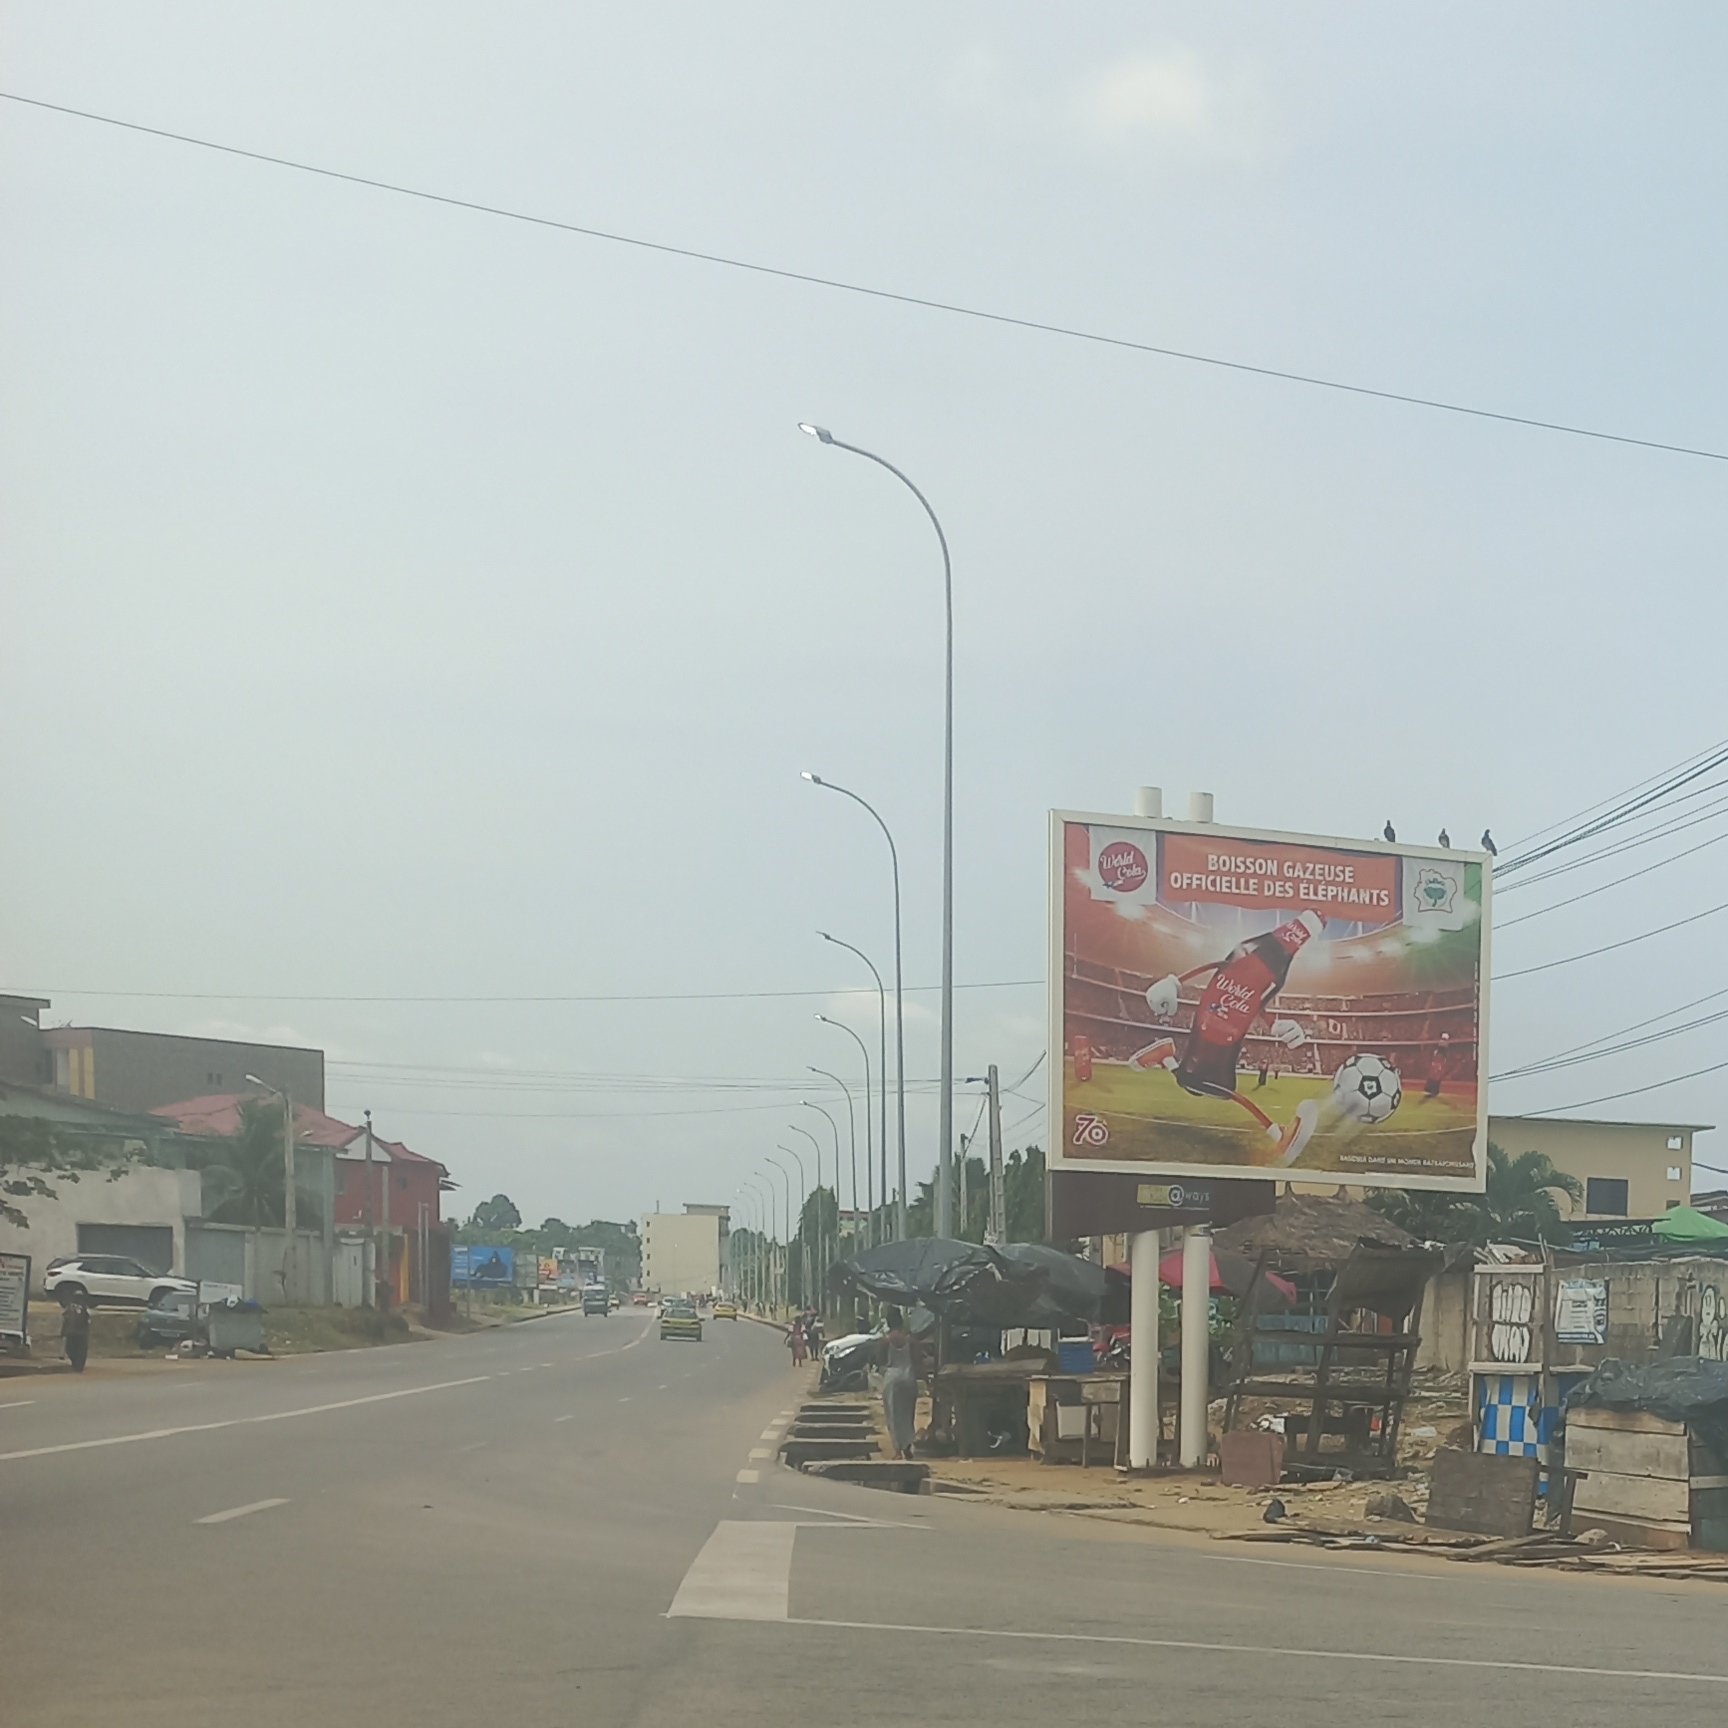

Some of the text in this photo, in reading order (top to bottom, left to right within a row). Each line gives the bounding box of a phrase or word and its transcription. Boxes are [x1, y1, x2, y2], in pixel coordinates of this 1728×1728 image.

[1100, 850, 1134, 869] World
[1207, 854, 1354, 882] BOISSON GAZEUSE
[1117, 863, 1146, 880] Cola
[1170, 872, 1389, 907] OFFICIELLE DES ÉLÉPHANTS
[1217, 974, 1255, 999] World
[1220, 994, 1250, 1013] Cola
